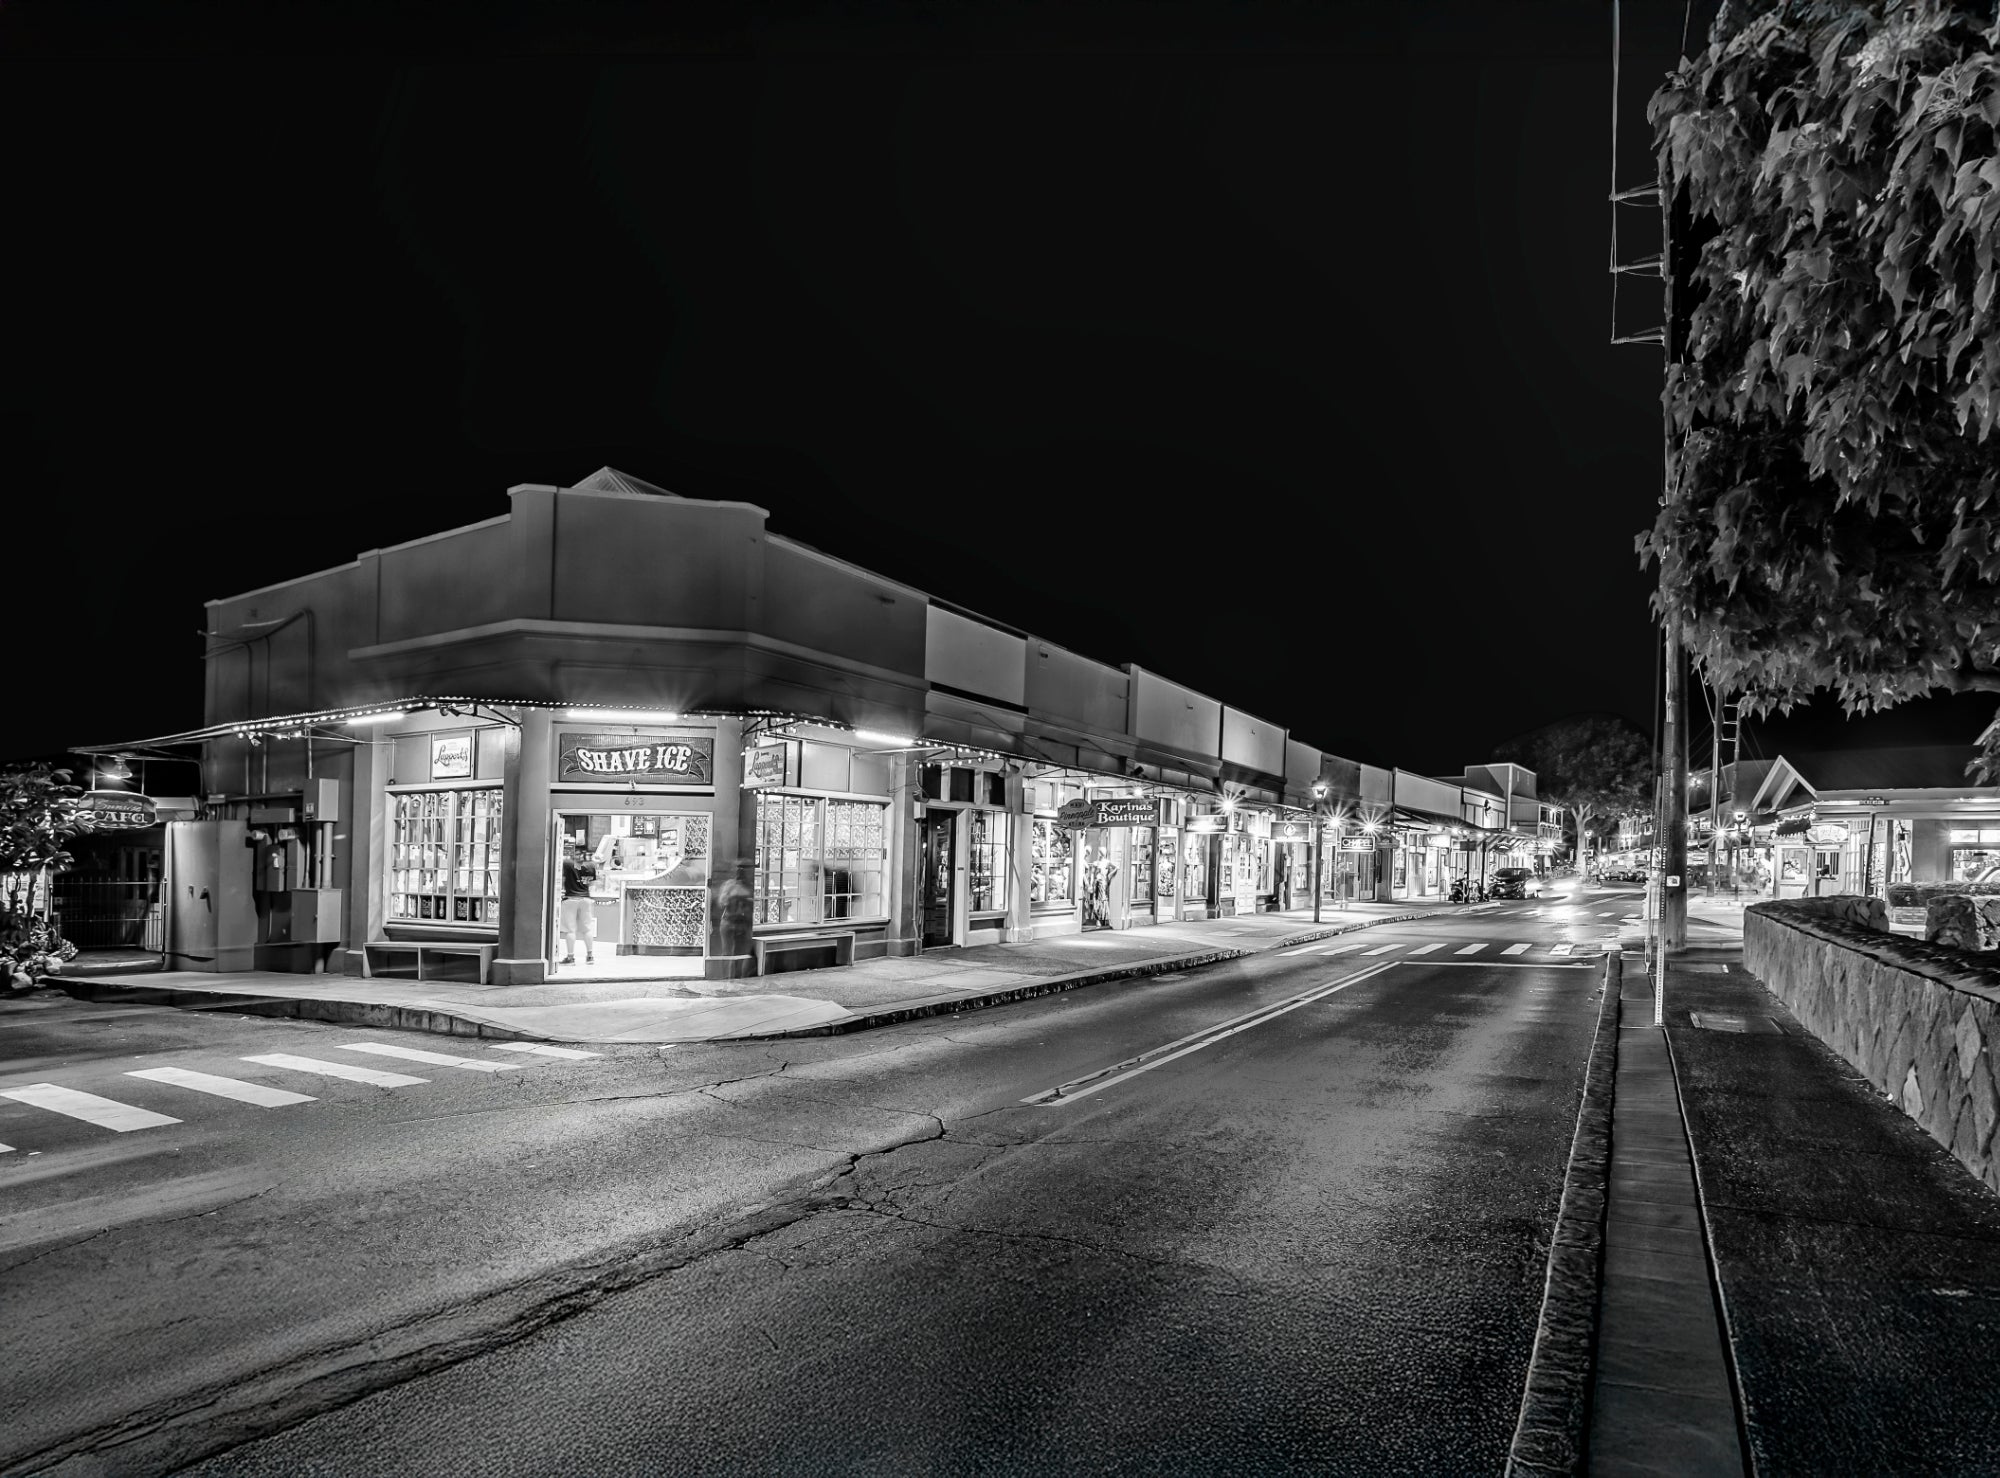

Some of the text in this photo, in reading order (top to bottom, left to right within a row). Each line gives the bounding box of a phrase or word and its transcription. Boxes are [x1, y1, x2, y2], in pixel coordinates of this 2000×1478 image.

[577, 745, 692, 773] SHAVE ICE
[1098, 811, 1155, 825] Boutique
